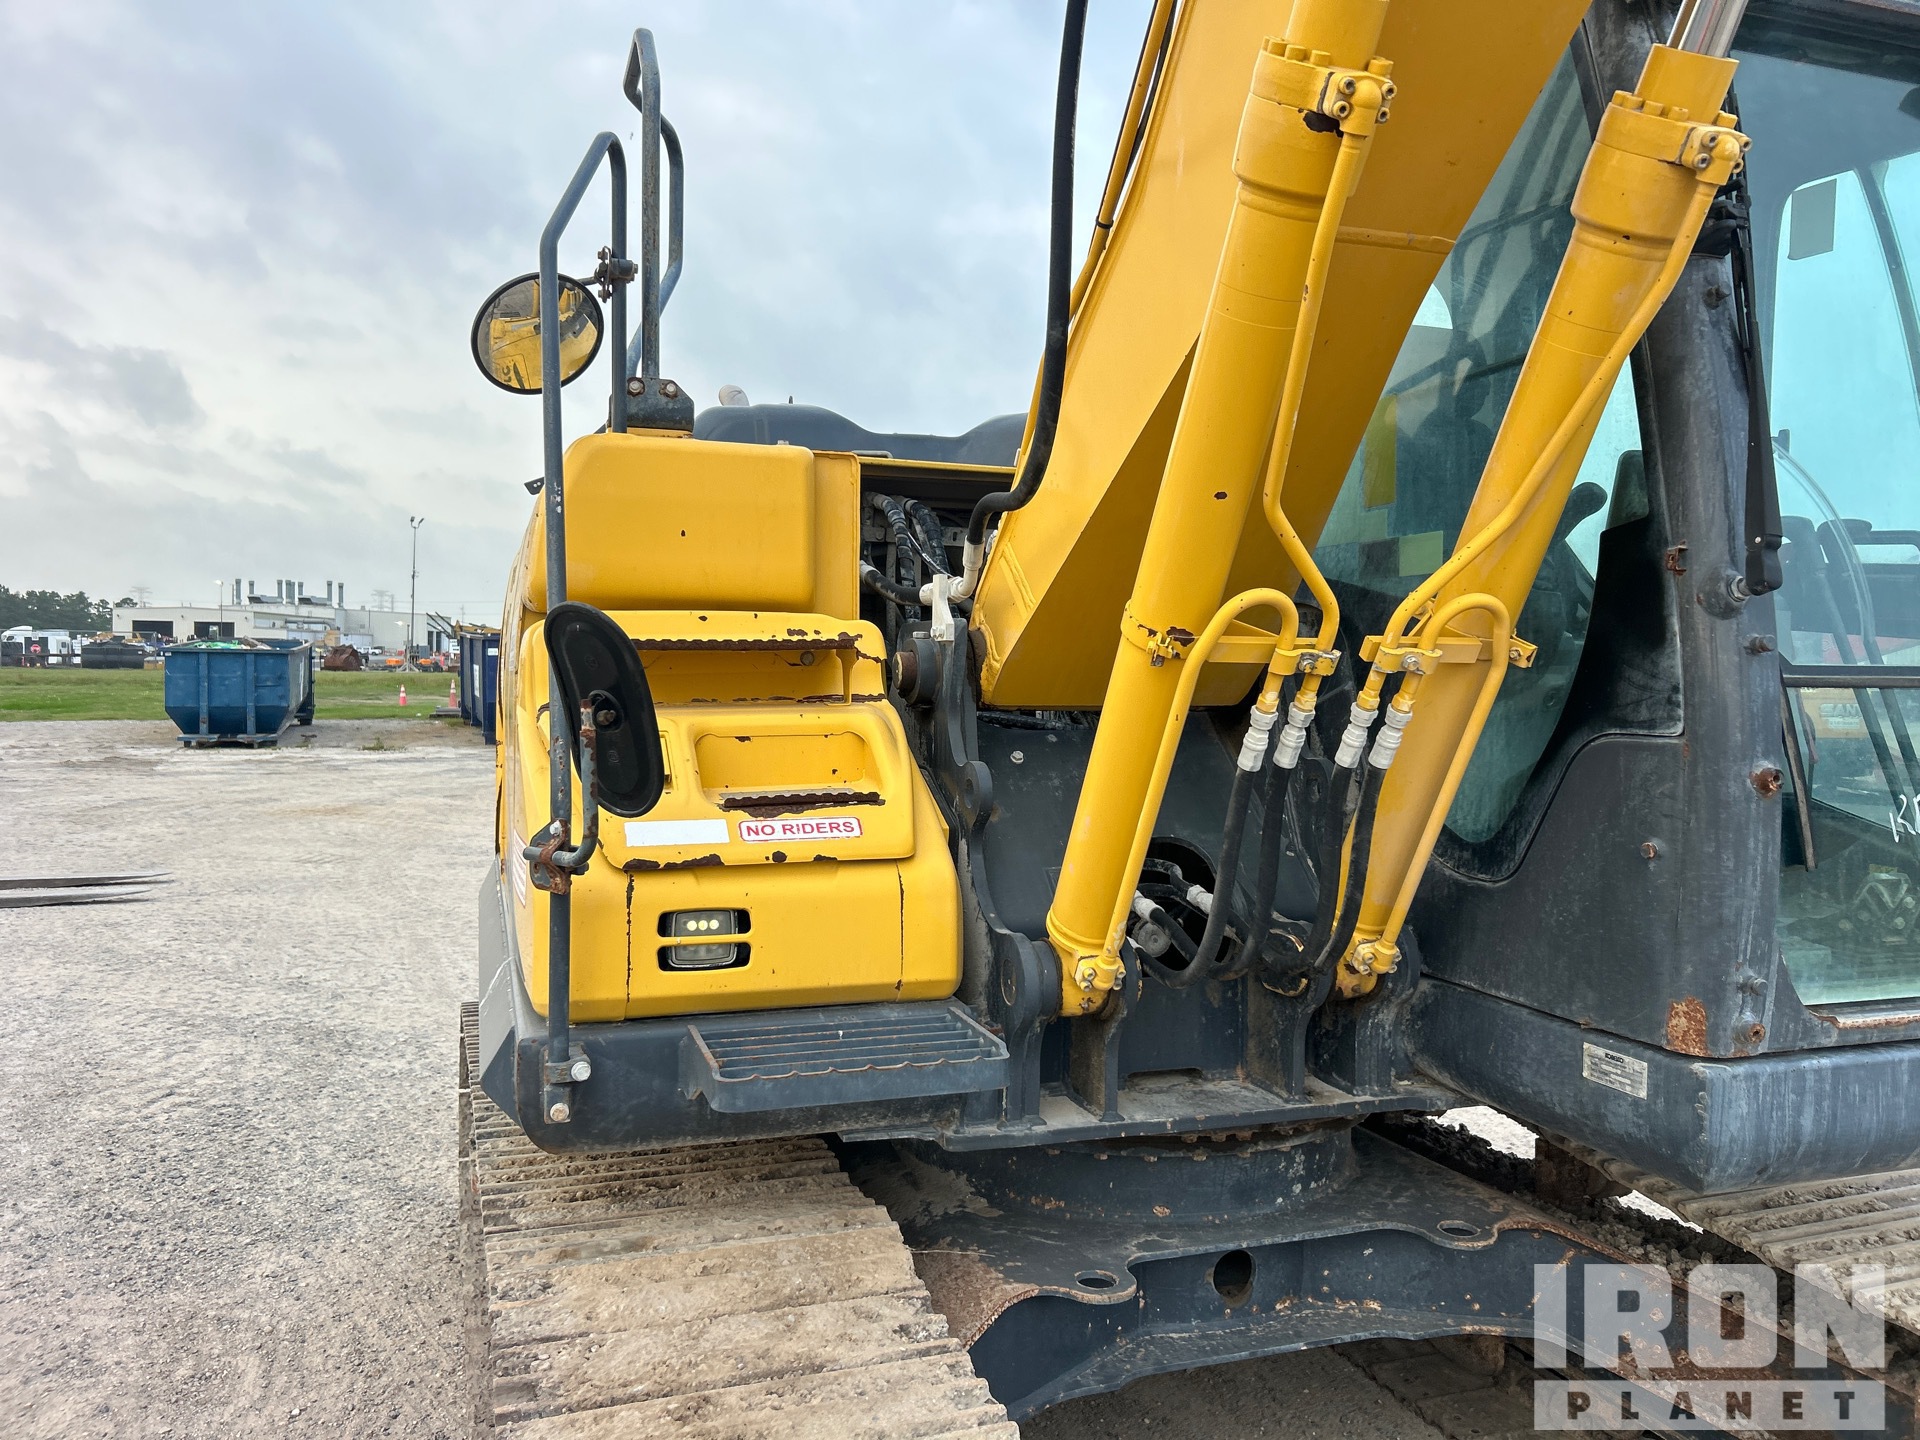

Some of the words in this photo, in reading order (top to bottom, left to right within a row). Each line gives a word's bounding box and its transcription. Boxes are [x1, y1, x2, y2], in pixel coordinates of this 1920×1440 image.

[1820, 704, 1862, 717] SAN
[746, 825, 775, 836] NO
[782, 822, 855, 835] RIDERS
